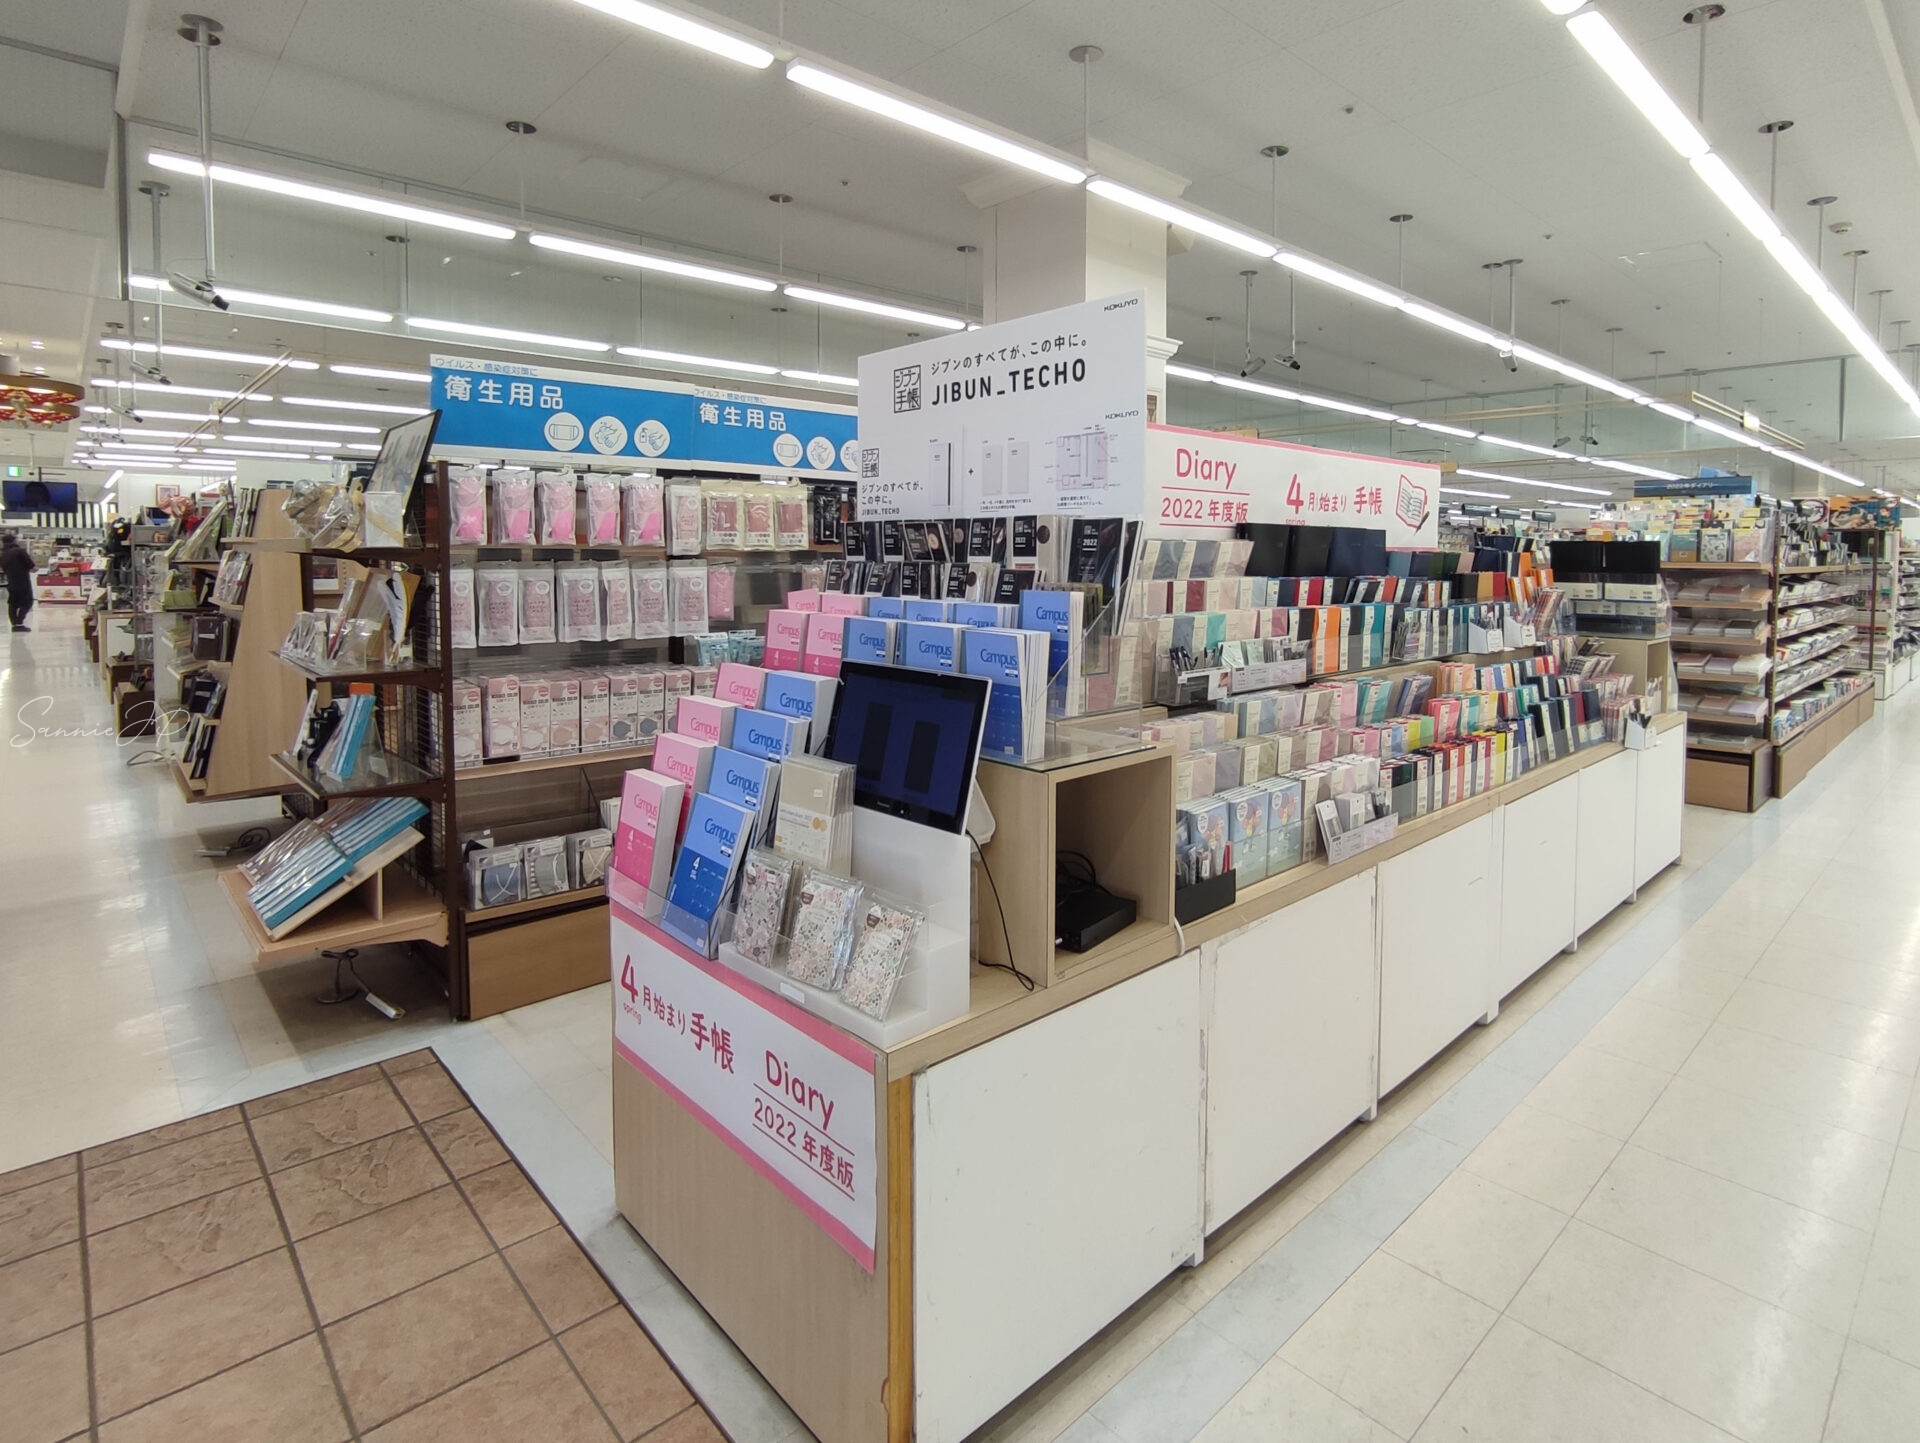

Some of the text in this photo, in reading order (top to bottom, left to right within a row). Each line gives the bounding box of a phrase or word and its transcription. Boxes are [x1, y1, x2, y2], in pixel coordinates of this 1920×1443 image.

[1104, 298, 1138, 311] KOKUYO
[931, 333, 1087, 376] ジブンのすべてが、この中に。
[444, 374, 564, 410] 衛生用品
[932, 358, 1086, 405] JIBUN_TECHO
[699, 402, 787, 431] 衛生用品
[1105, 410, 1139, 420] KOKUYO
[1176, 447, 1237, 490] Diary
[1082, 538, 1098, 546] 2022
[1036, 606, 1069, 624] Campus
[777, 623, 800, 637] Campus
[859, 633, 886, 649] Campus
[919, 640, 952, 658] Campus
[980, 648, 1018, 669] Campus
[729, 681, 758, 700] Campus
[779, 693, 813, 713] Campus
[690, 717, 719, 739] Campus
[748, 729, 782, 753] Campus
[666, 756, 695, 778] Campus
[726, 769, 760, 794] Campus
[634, 793, 658, 818] Campus
[704, 817, 737, 846] Campus
[692, 856, 701, 871] 4
[623, 1002, 642, 1024] spring
[766, 1049, 835, 1131] Diary
